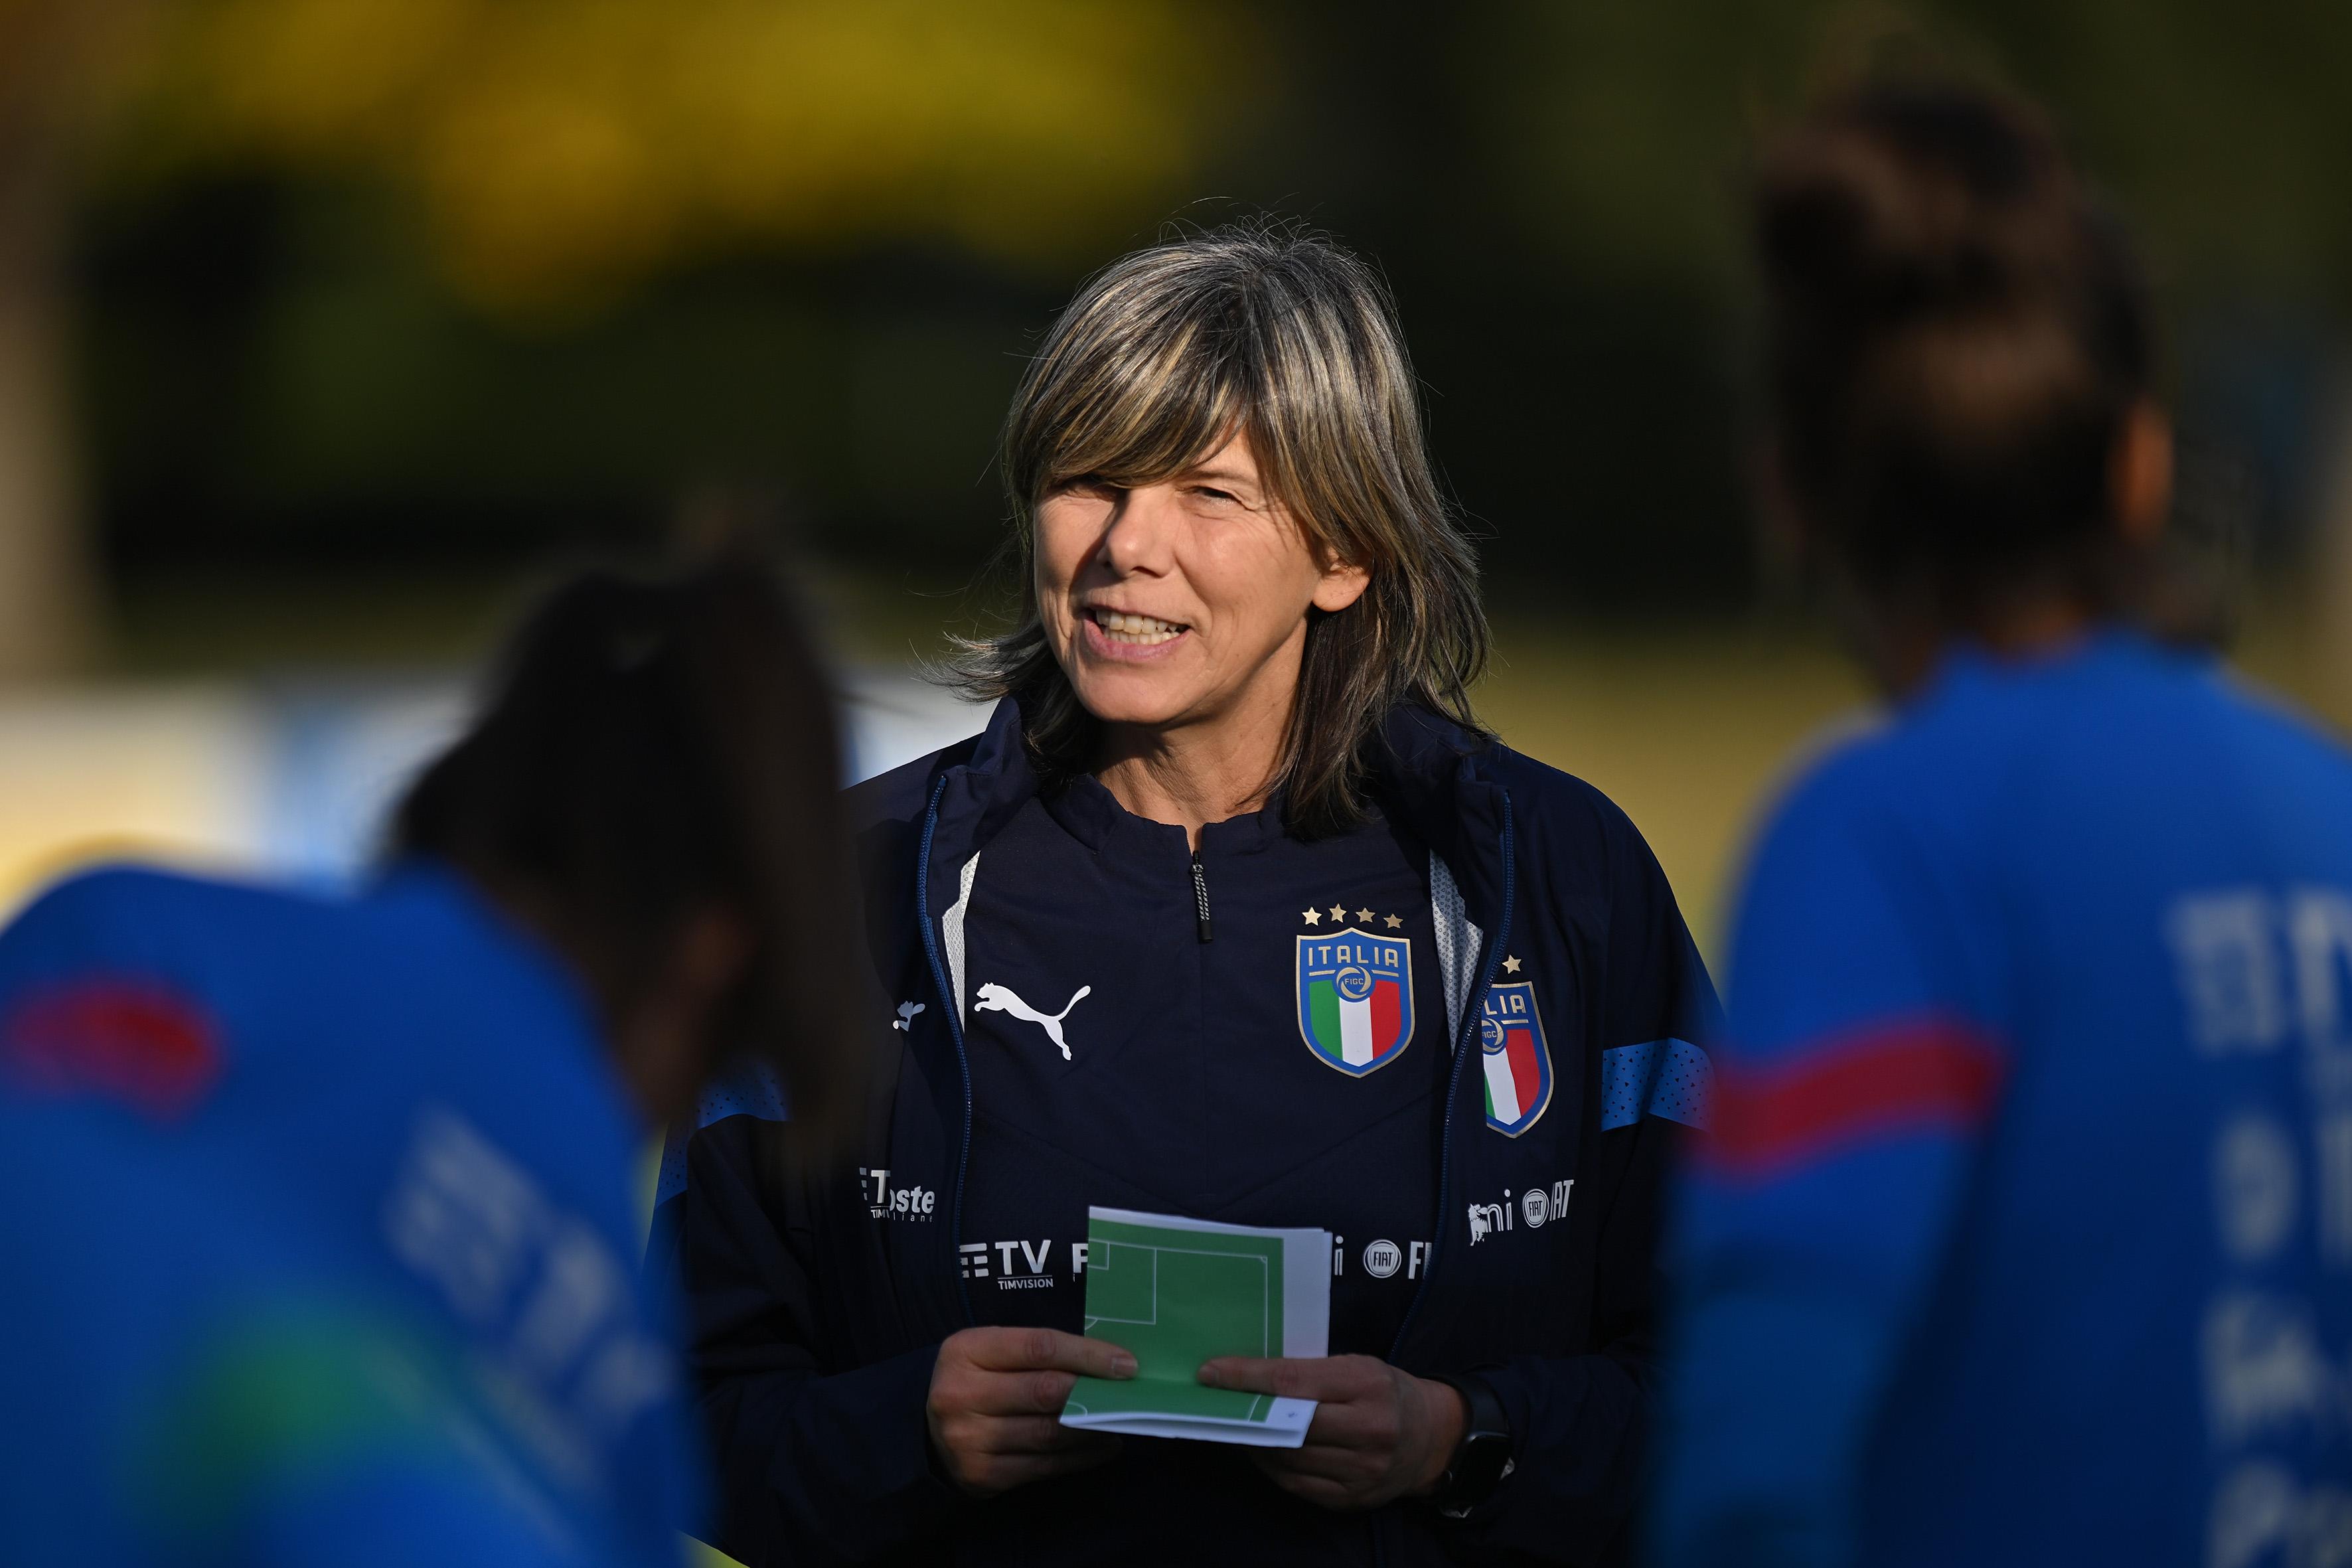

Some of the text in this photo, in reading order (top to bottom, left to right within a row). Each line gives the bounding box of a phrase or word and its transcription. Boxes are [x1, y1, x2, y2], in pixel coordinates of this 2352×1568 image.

[1308, 945, 1399, 968] ITALIA
[1528, 1200, 1543, 1217] FIAT
[1549, 1179, 1575, 1221] AT
[995, 1239, 1052, 1275] TV
[1373, 1251, 1393, 1267] FIAT
[998, 1279, 1054, 1290] TIMVISION
